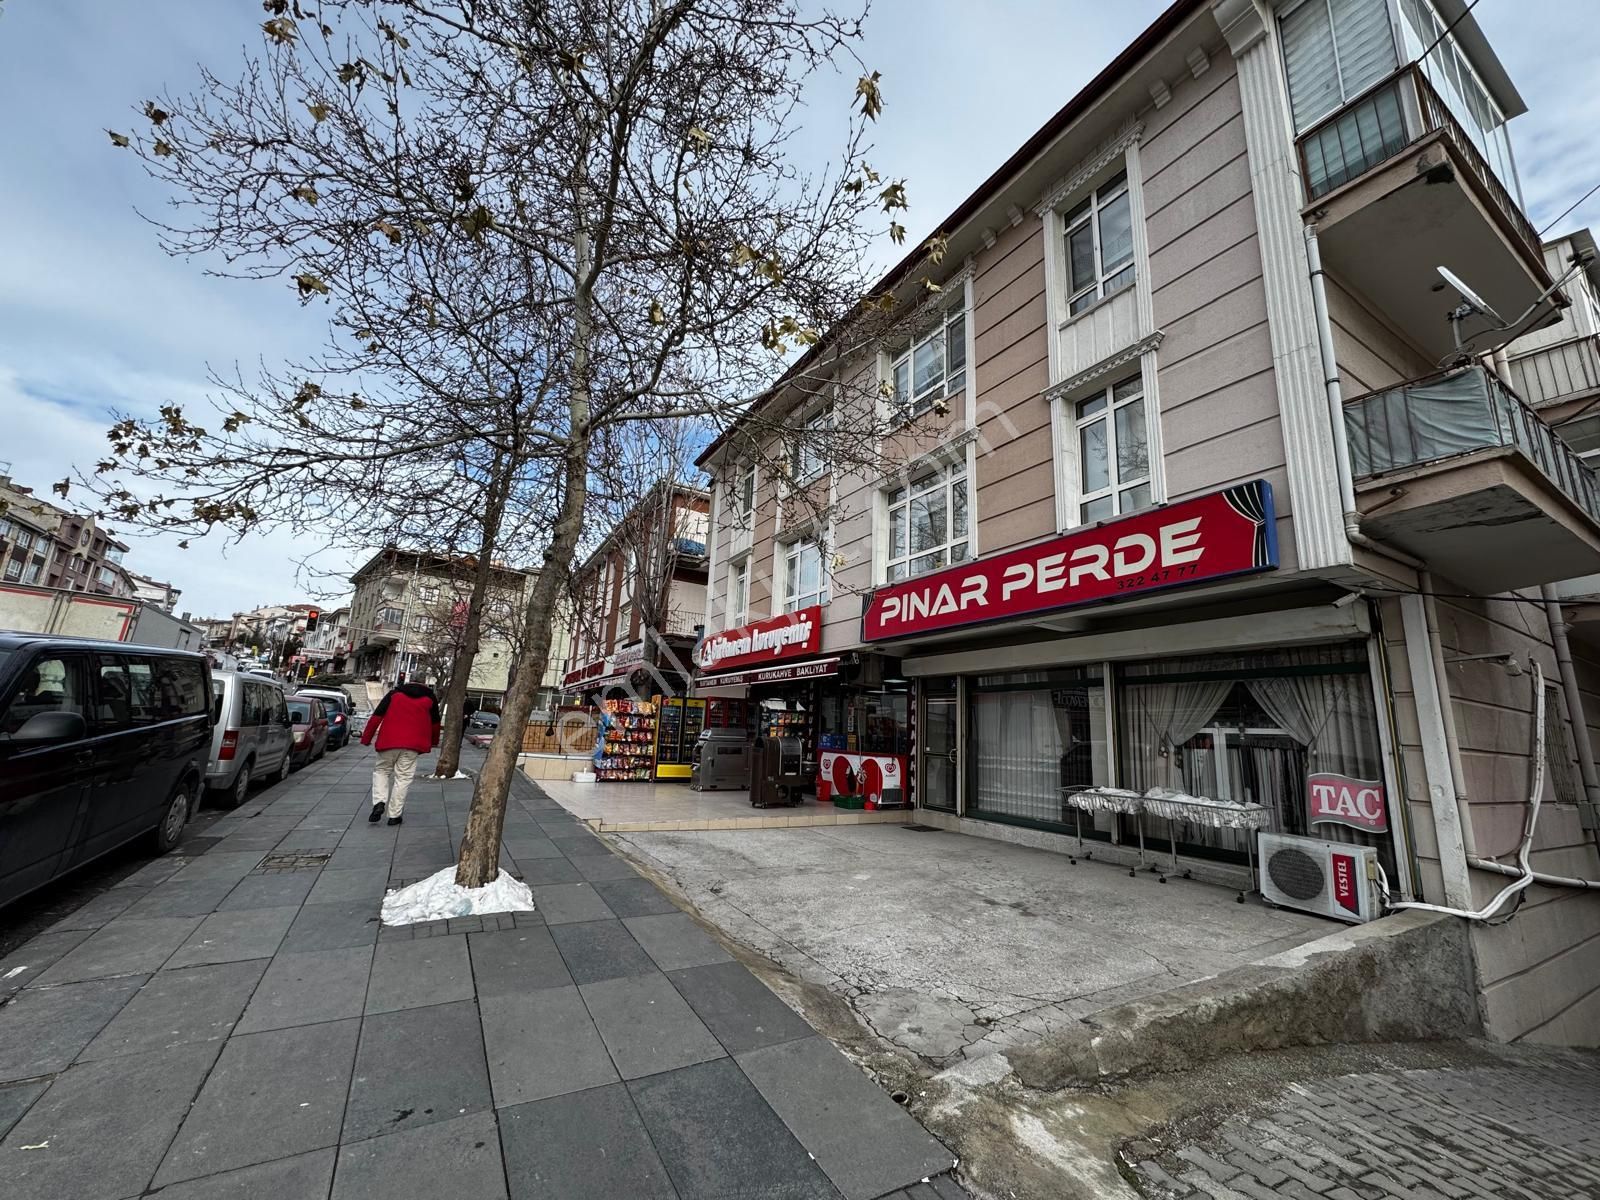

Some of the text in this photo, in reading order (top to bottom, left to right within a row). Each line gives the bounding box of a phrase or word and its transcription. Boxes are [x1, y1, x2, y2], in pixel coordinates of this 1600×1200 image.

[880, 516, 1205, 627] PINAR PERDE
[1116, 563, 1199, 590] 322 47 77
[758, 668, 792, 680] KURUKAHVE
[1312, 784, 1382, 820] TAC
[1337, 860, 1349, 897] VESTEL
